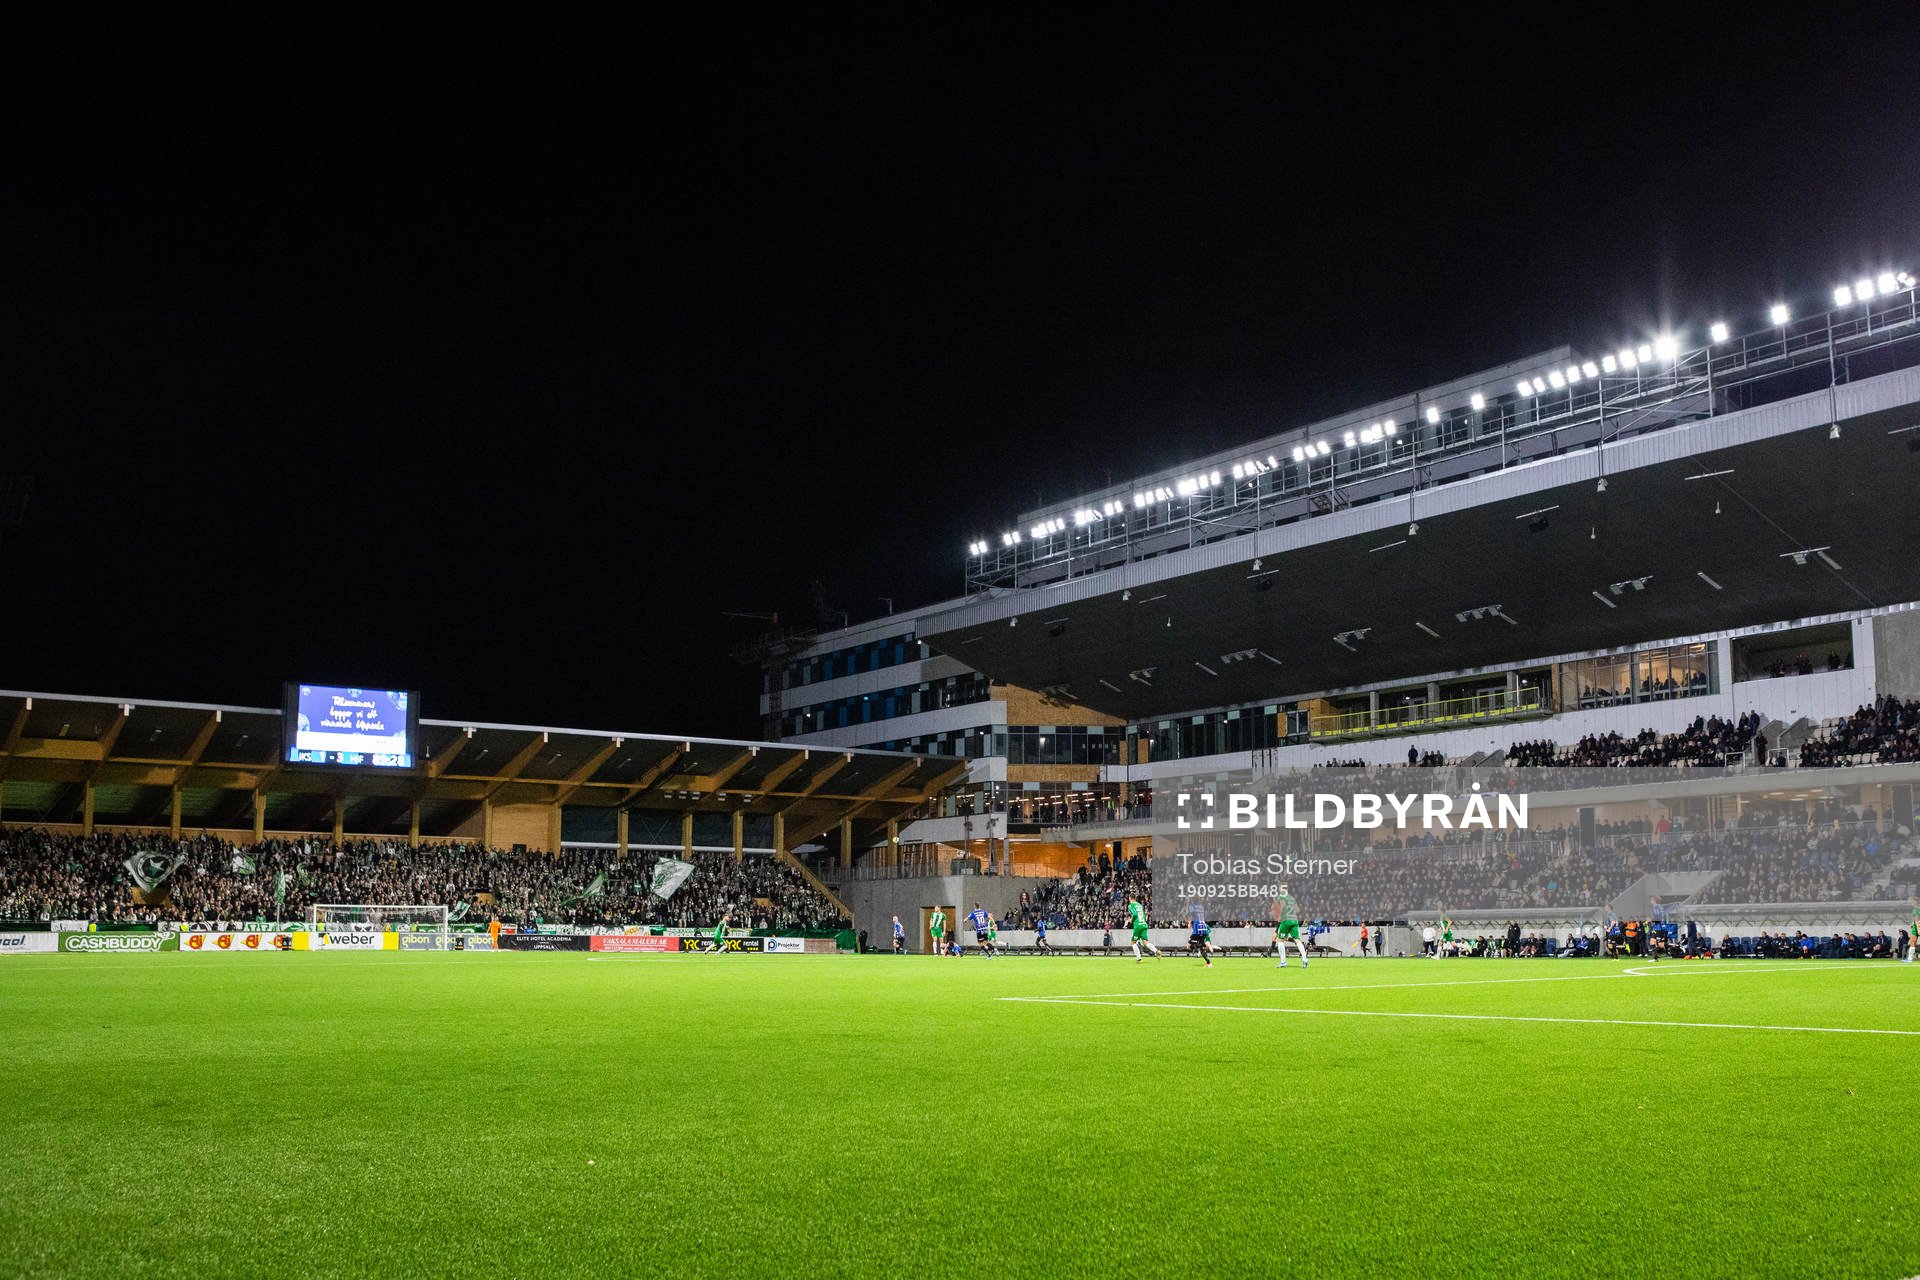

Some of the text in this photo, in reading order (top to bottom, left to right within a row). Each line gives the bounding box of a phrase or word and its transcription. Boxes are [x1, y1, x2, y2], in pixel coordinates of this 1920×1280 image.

[976, 916, 985, 924] 10
[67, 934, 162, 951] CASHBUDDY
[329, 933, 375, 945] weber
[401, 934, 430, 949] gibon
[684, 939, 700, 950] YRC
[726, 939, 742, 950] YRC
